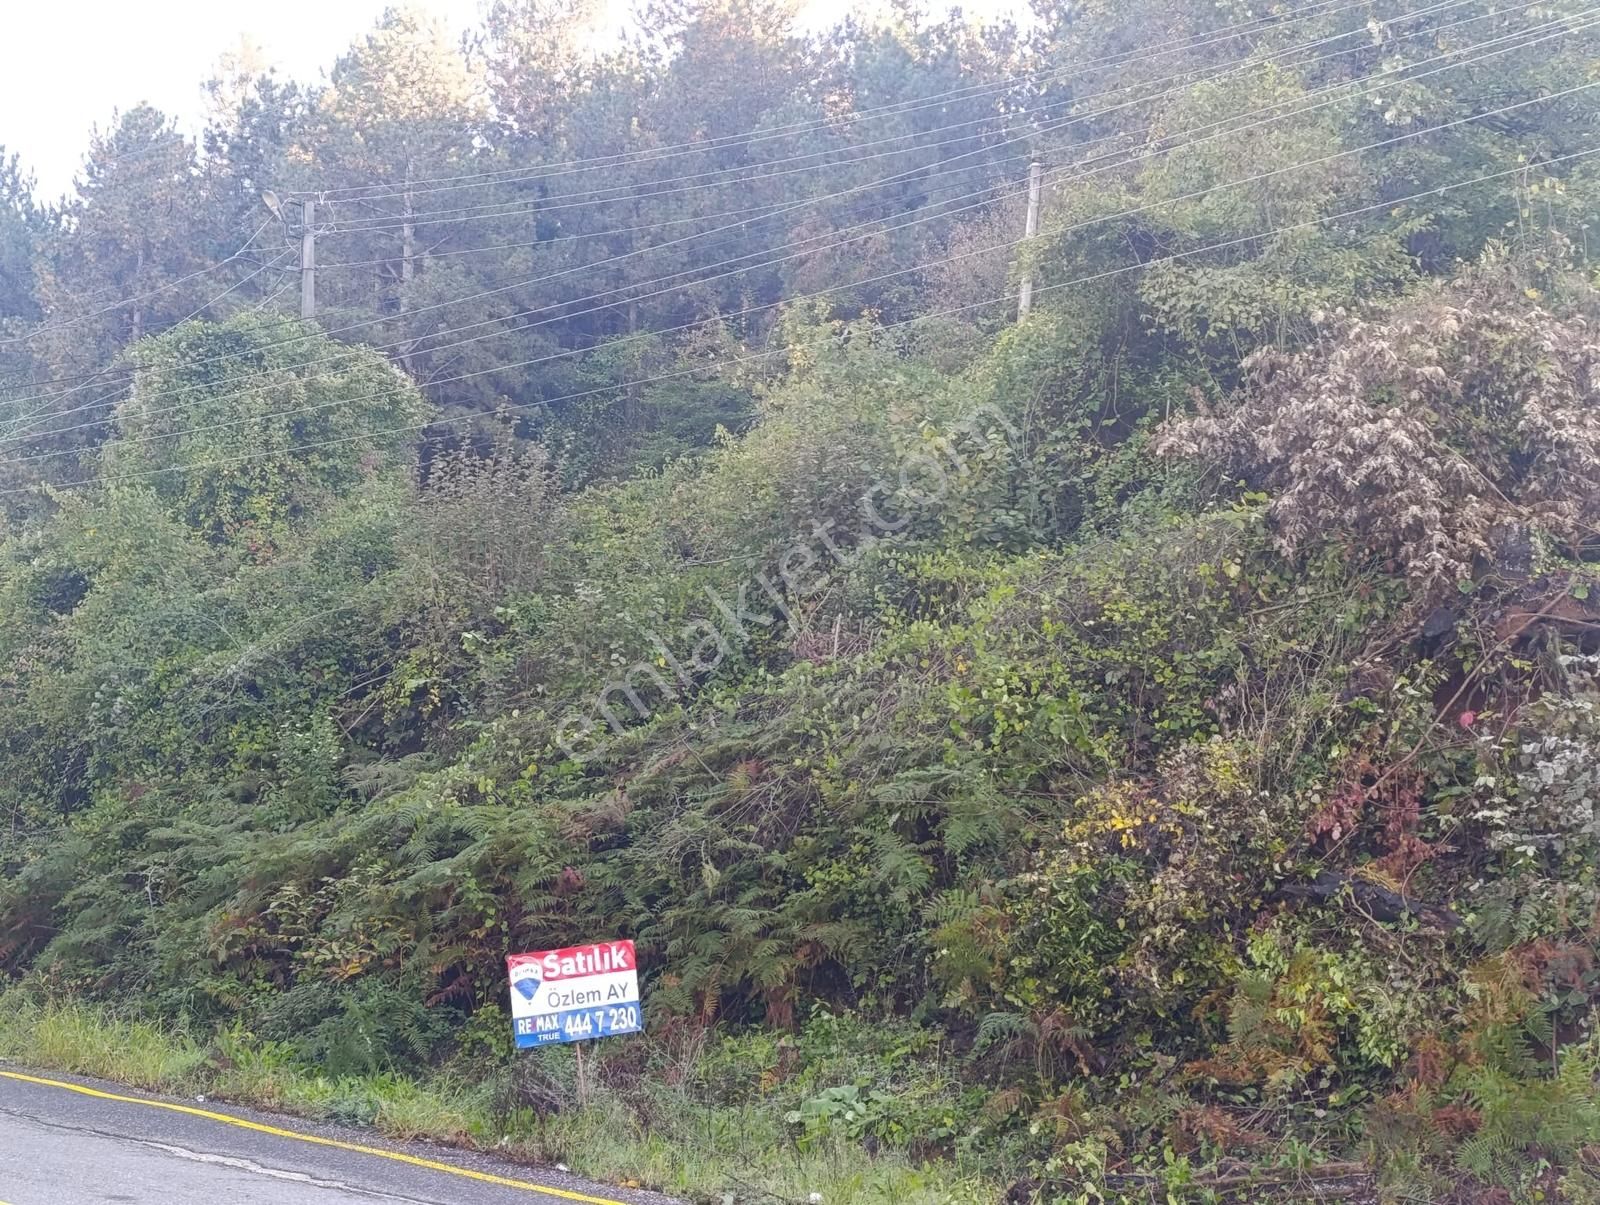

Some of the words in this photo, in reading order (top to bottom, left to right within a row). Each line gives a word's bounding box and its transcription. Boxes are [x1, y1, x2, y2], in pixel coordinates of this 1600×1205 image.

[543, 946, 628, 978] Satılık
[547, 987, 601, 1008] Özlem
[607, 982, 628, 1000] AY
[565, 1013, 592, 1037] 444
[595, 1011, 604, 1033] 7
[609, 1006, 637, 1031] 230
[537, 1031, 560, 1042] TRUE
